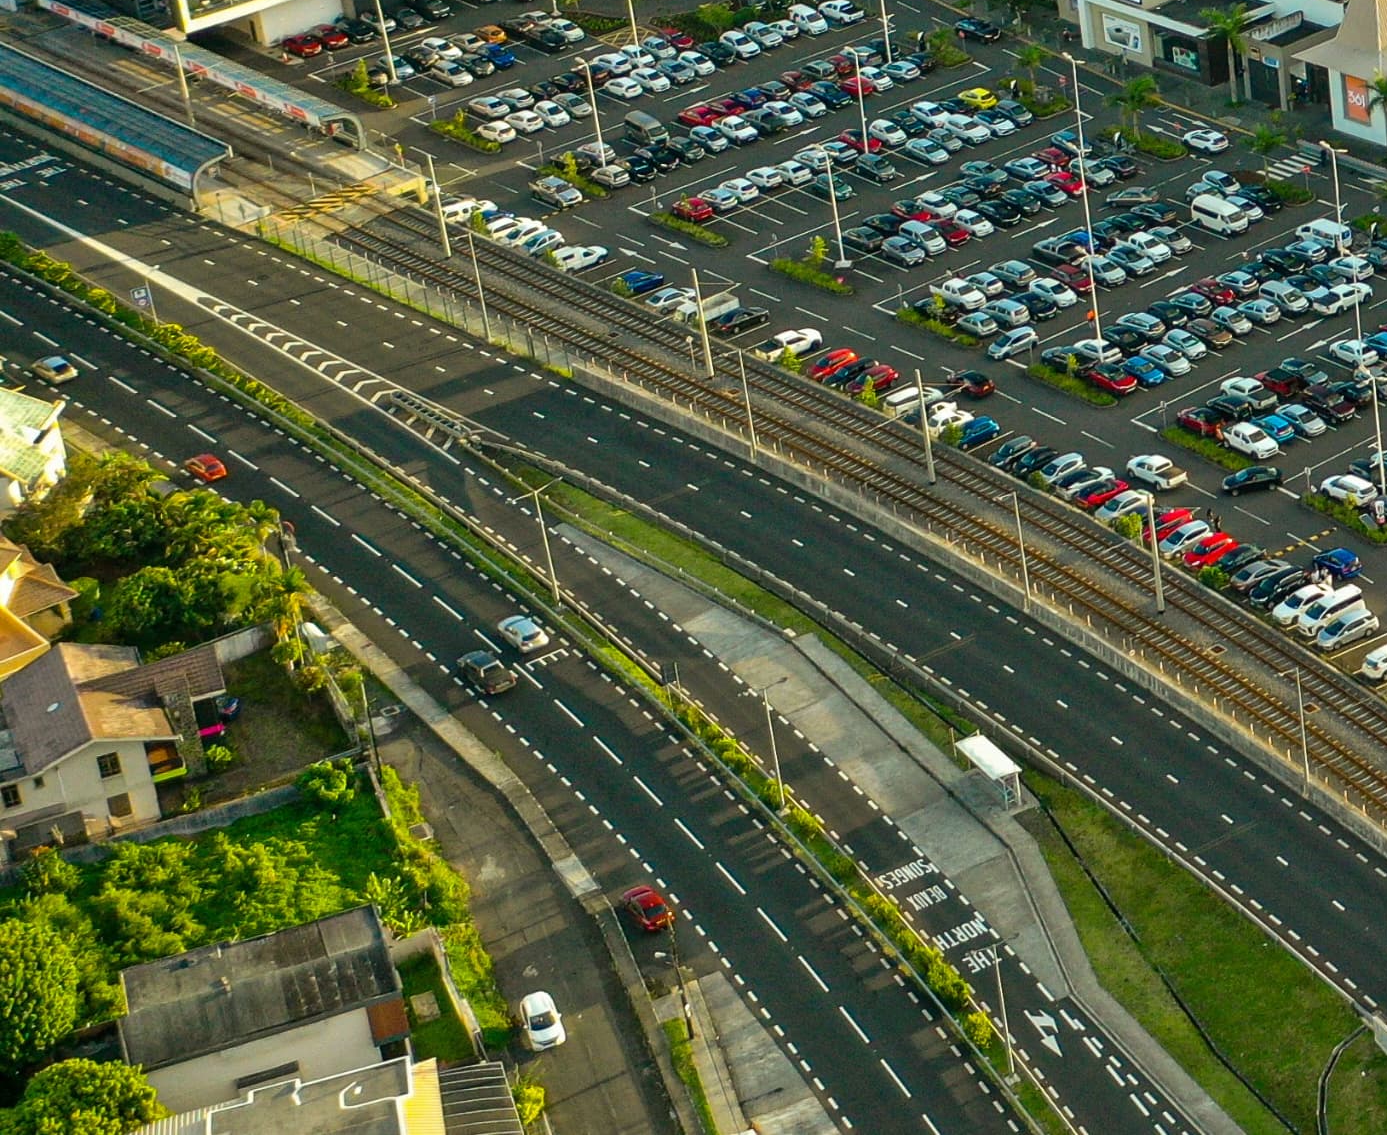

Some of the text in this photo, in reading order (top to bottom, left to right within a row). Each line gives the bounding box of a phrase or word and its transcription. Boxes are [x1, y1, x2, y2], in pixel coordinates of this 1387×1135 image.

[879, 858, 932, 890] SONGES
[905, 884, 948, 911] BEAUX
[932, 917, 989, 951] NORTH
[961, 947, 1003, 974] THE
